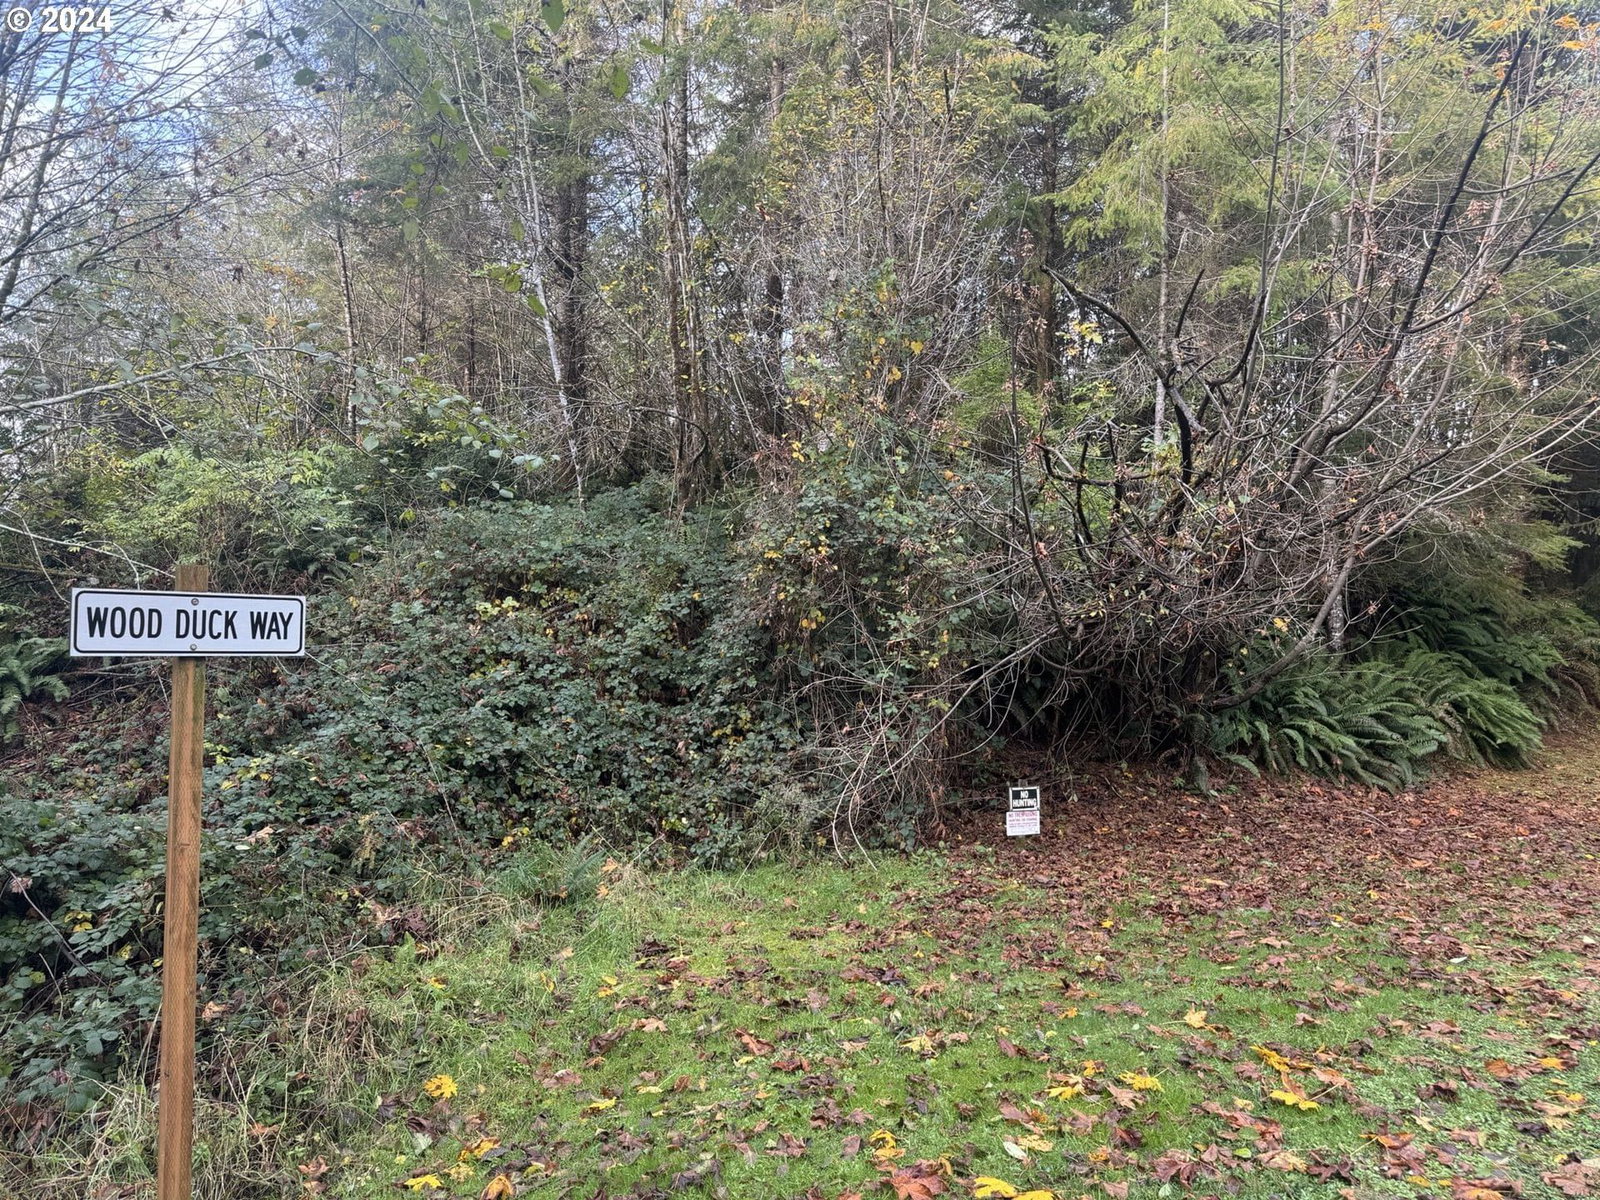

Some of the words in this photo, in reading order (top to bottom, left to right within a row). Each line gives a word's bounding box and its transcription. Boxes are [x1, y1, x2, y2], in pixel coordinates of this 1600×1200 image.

[87, 607, 162, 639] WOOD
[175, 609, 238, 640] DUCK
[250, 611, 294, 640] WAY
[1020, 791, 1029, 799] NO
[1013, 798, 1037, 807] HUNTING
